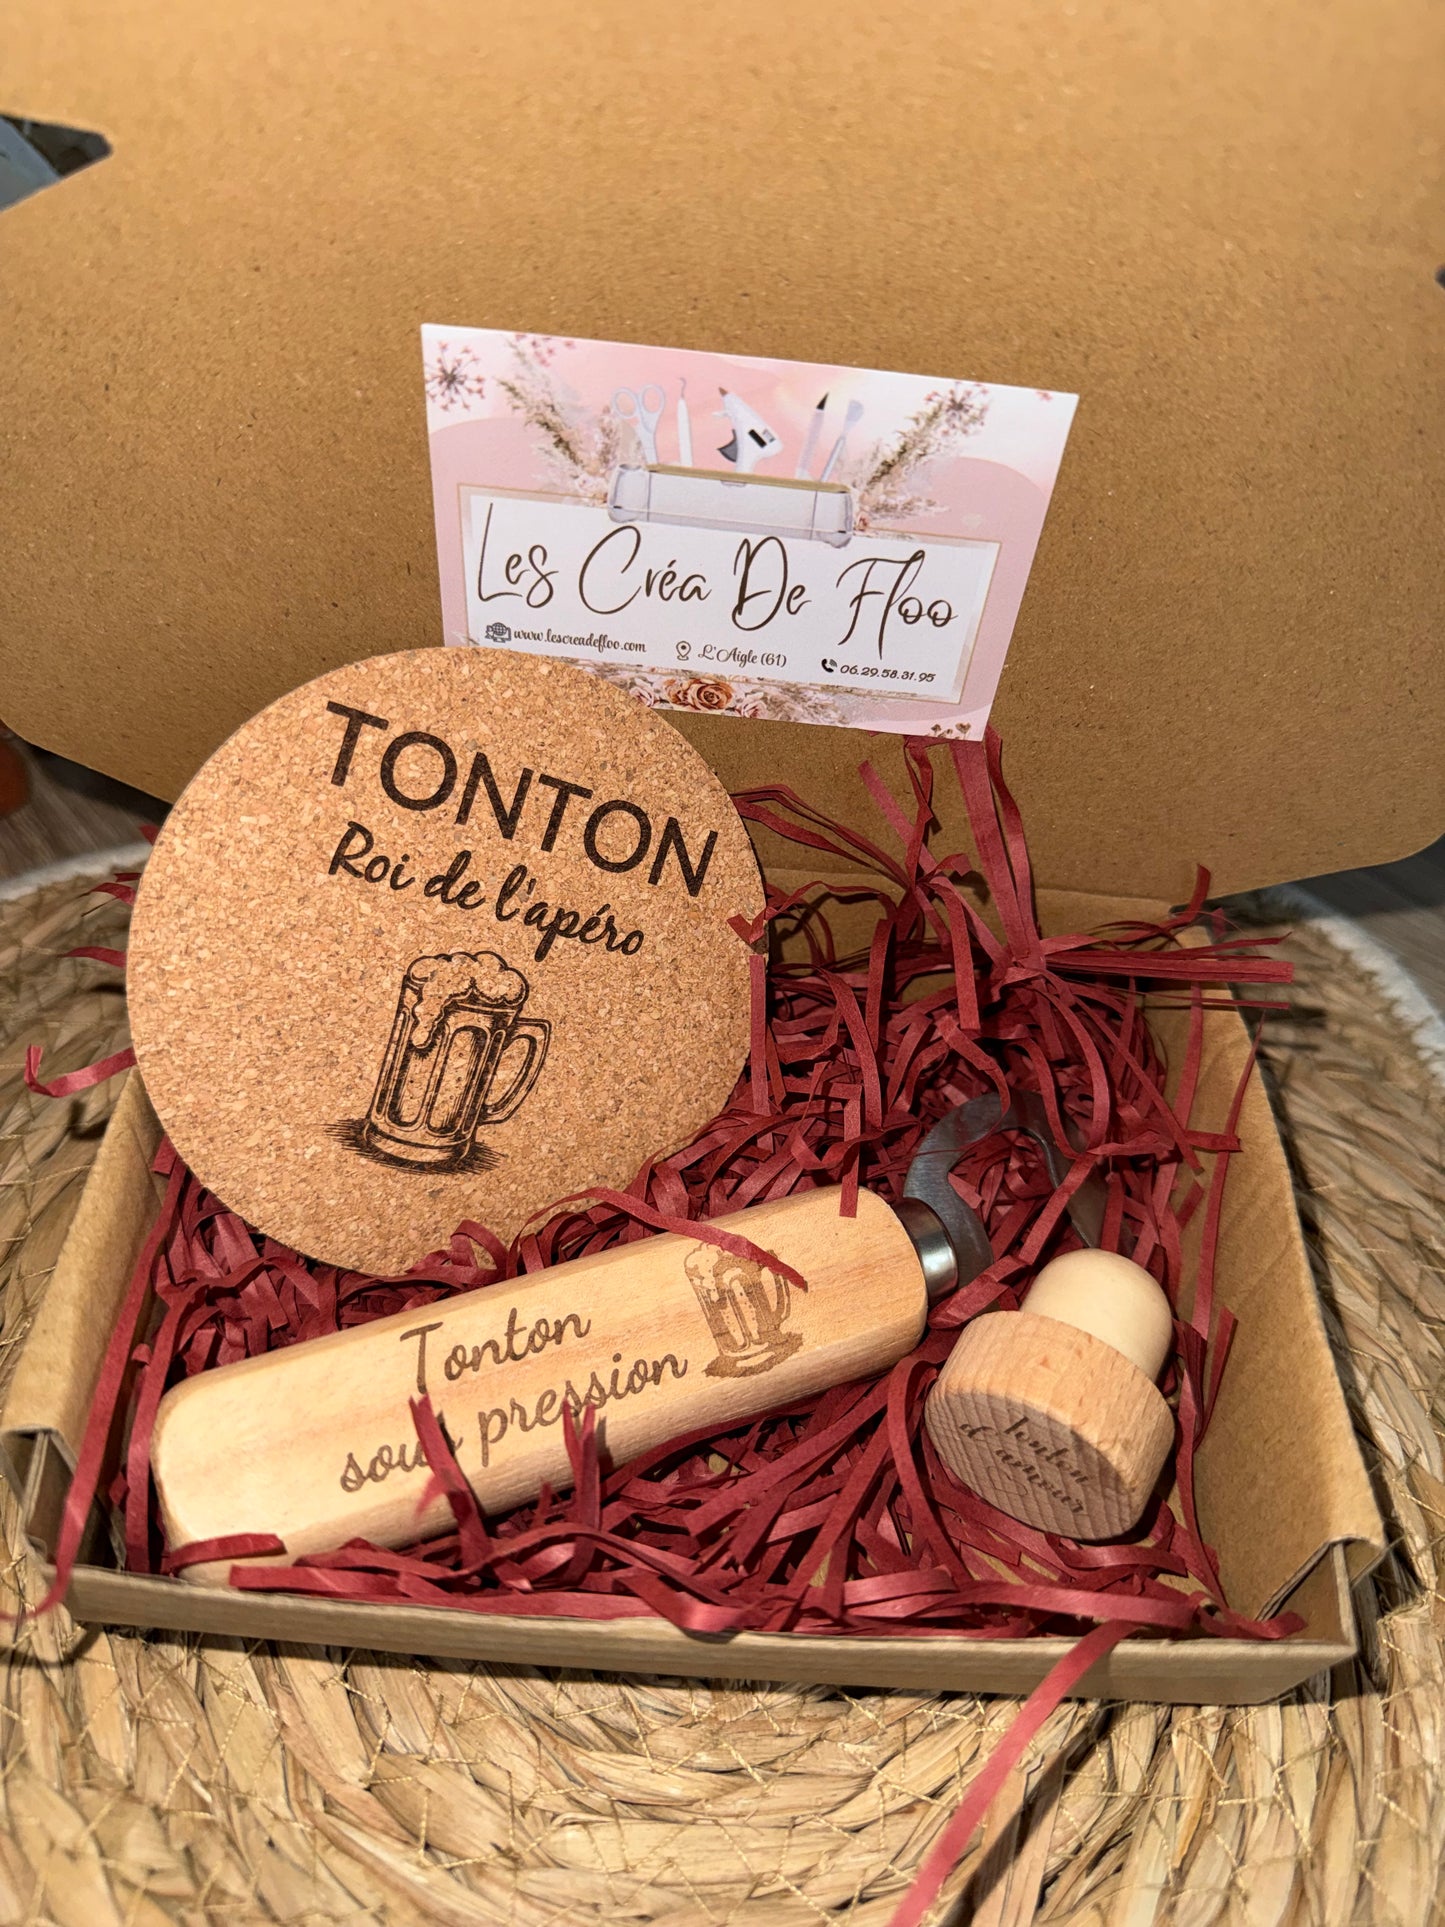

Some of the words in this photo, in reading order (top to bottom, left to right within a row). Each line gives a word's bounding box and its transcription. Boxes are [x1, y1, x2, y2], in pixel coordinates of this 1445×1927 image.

[477, 502, 560, 609] Les
[578, 525, 713, 615] Créa
[731, 536, 812, 632] De
[835, 549, 959, 661] Floo
[513, 628, 647, 653] www.lescreadefloo.com
[697, 643, 758, 668] L'Aigle
[760, 653, 787, 669] (61)
[839, 664, 937, 683] 06.29.58.31.95
[326, 701, 719, 898] TONTON
[328, 821, 416, 890] Roi
[424, 850, 487, 910] de
[495, 864, 645, 962] l'apéro
[400, 1307, 591, 1394] Tonton
[340, 1437, 463, 1492] sou
[478, 1353, 688, 1467] pression
